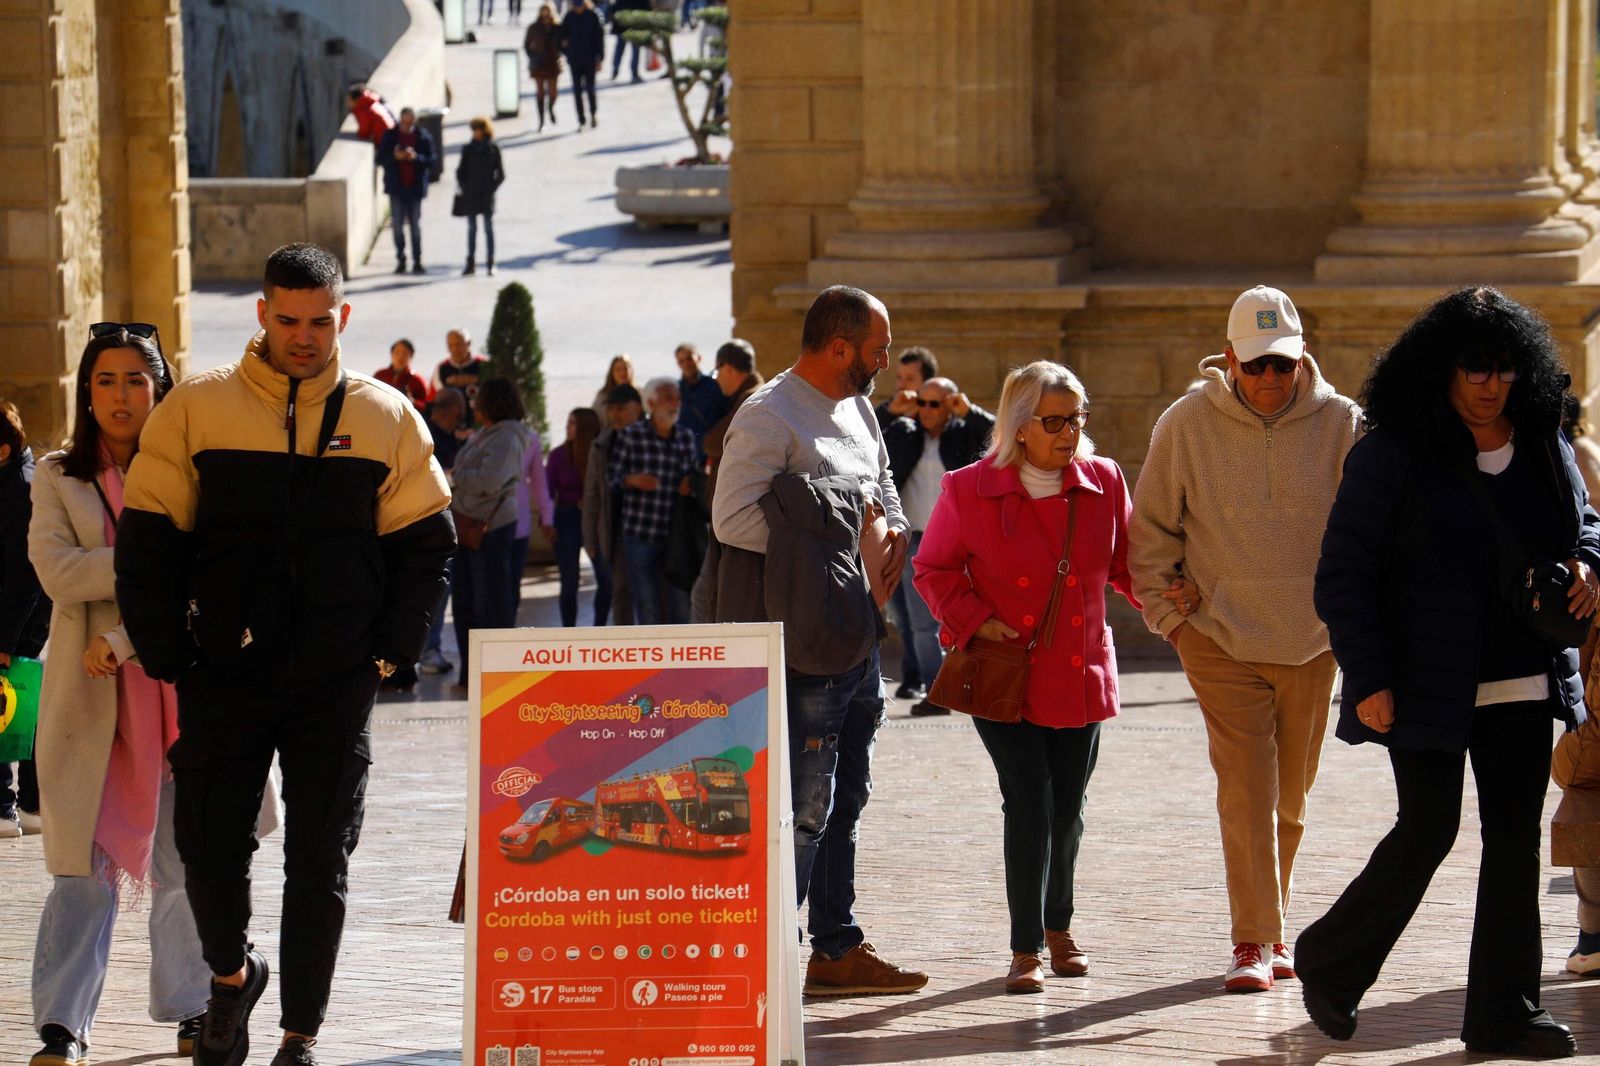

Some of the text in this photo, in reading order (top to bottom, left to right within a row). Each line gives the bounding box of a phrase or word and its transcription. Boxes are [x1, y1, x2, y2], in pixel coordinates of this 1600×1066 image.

[522, 645, 726, 664] AQUÍ TICKETS HERE
[519, 699, 728, 723] CitySightseeing Córdoba
[581, 730, 599, 740] Hop
[602, 730, 615, 739] On
[629, 730, 647, 740] Hop
[650, 728, 665, 738] Off
[497, 776, 538, 790] OFFICIAL
[510, 786, 529, 794] TOUR
[494, 883, 750, 906] ¡Córdoba en un solo ticket!
[485, 908, 758, 928] Cordoba with just one ticket!
[558, 984, 603, 995] Bus stops
[664, 983, 726, 993] Walking tours
[530, 986, 553, 1004] 17
[558, 995, 596, 1003] Paradas
[664, 993, 695, 1002] Paseos
[709, 993, 723, 1002] pie
[699, 1044, 755, 1053] 900 920 092
